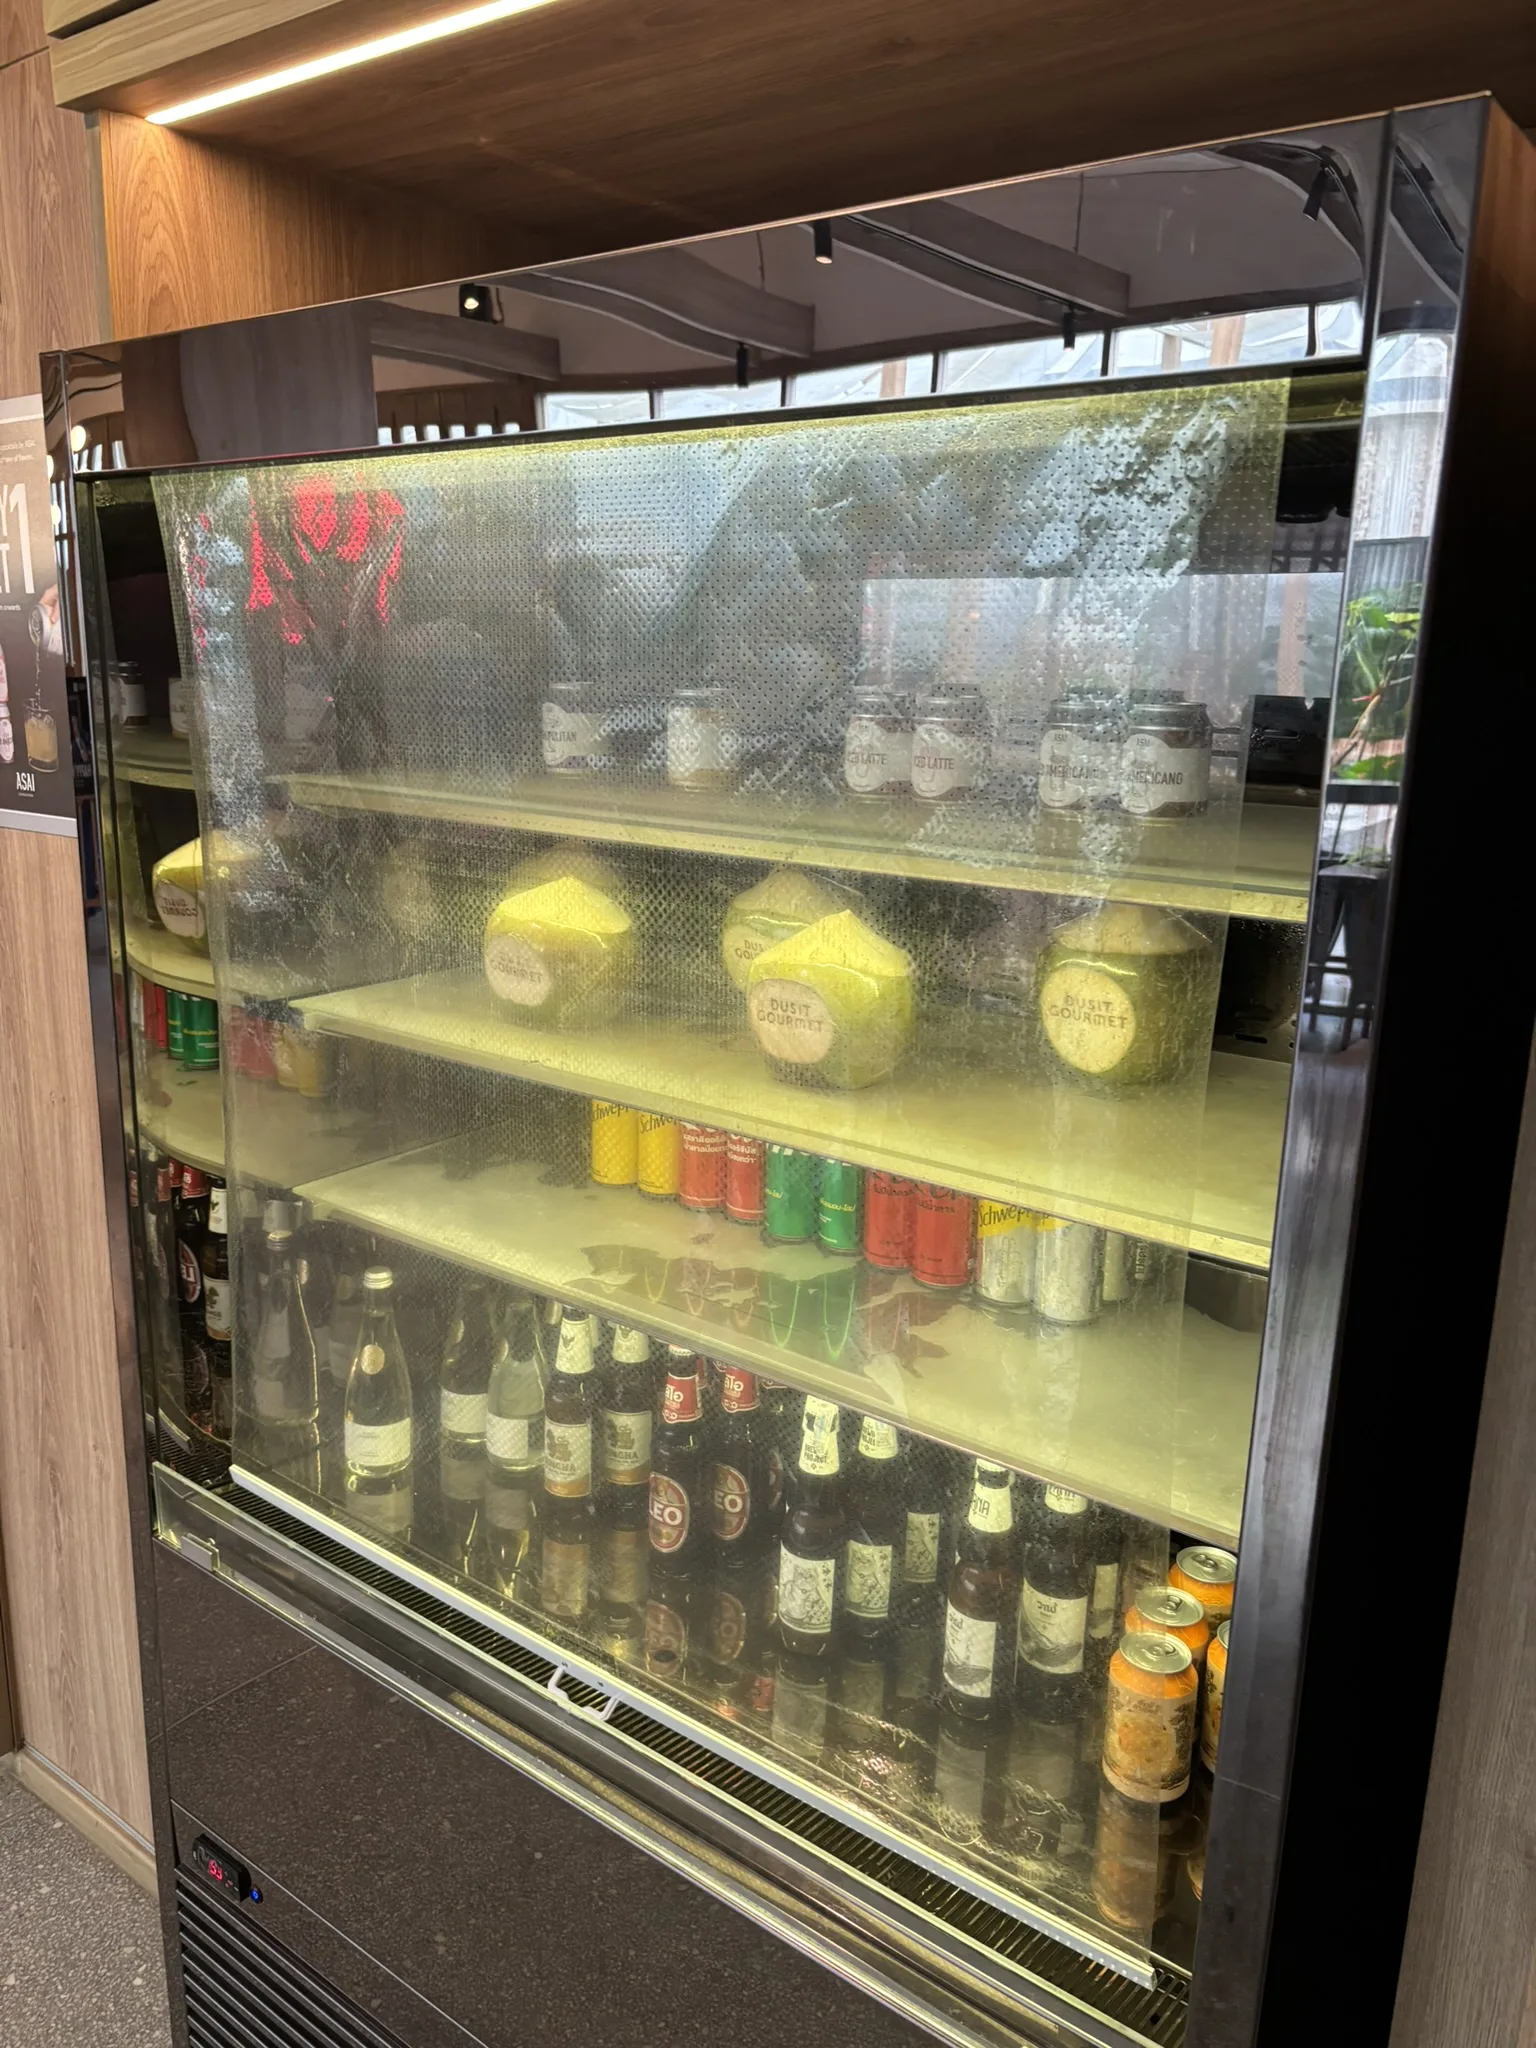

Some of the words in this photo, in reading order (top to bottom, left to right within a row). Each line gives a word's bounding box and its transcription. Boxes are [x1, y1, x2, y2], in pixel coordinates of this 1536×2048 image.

[9, 483, 35, 594] 1
[927, 756, 955, 770] LATTE
[16, 771, 36, 792] ASAI
[744, 939, 765, 953] DUS
[770, 998, 811, 1017] DUSIT
[1065, 994, 1113, 1014] DUSIT
[757, 1009, 824, 1032] GOURMET
[1050, 1005, 1128, 1029] GOURMET
[979, 1204, 1030, 1228] Schwep
